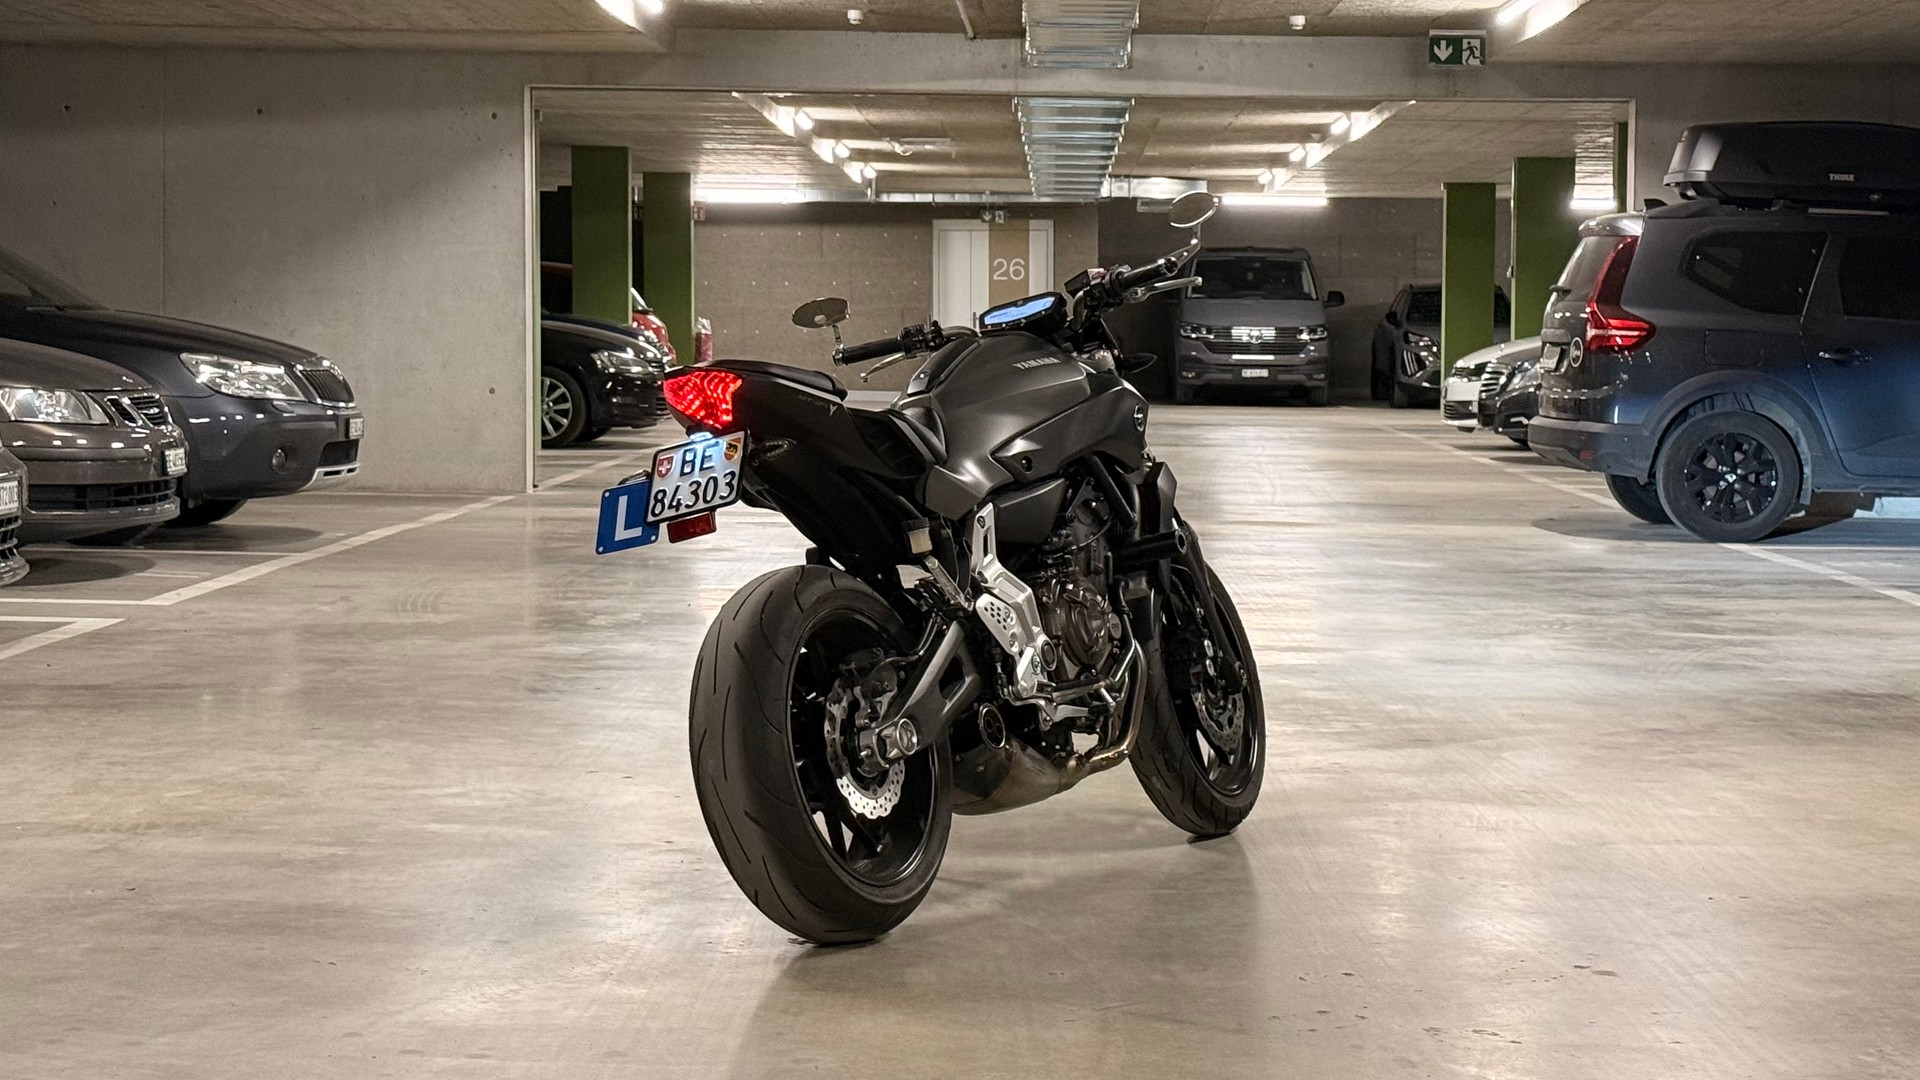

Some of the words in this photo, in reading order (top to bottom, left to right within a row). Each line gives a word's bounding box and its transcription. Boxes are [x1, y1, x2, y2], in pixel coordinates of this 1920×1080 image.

[993, 258, 1025, 280] 26
[1012, 356, 1061, 370] YAMAHA
[680, 440, 719, 477] BE
[650, 470, 736, 518] 84303
[614, 494, 643, 542] L
